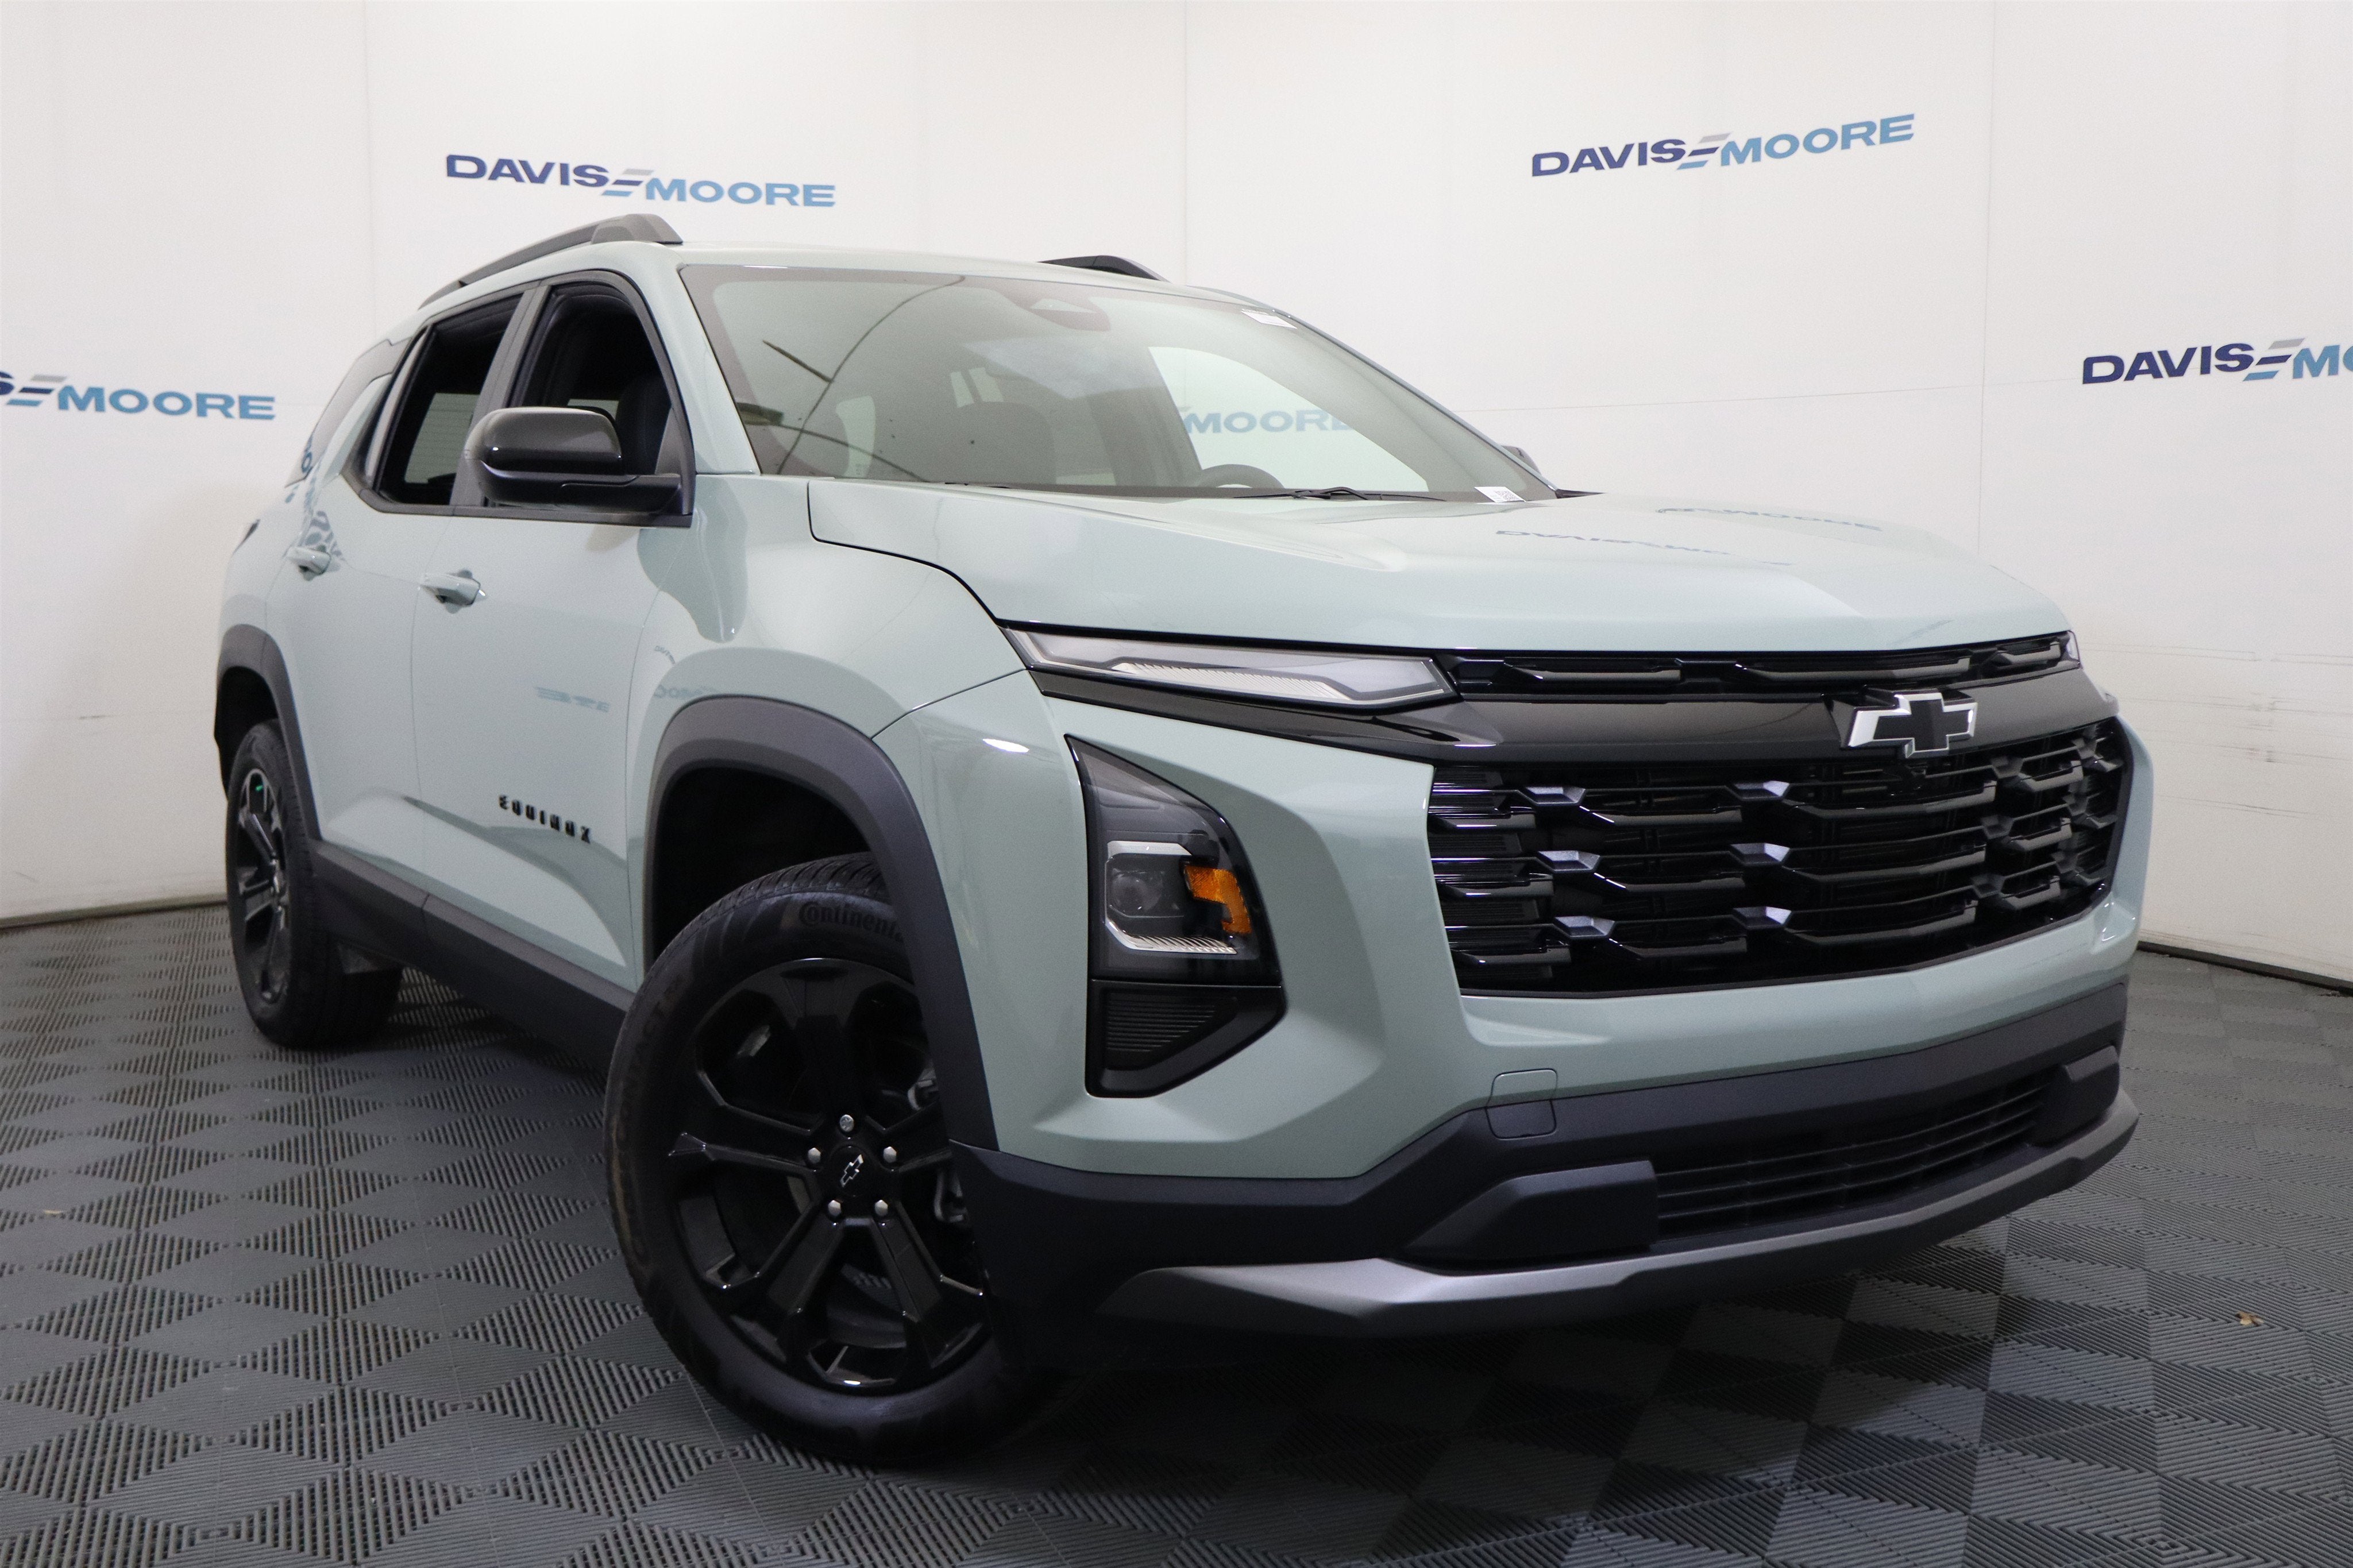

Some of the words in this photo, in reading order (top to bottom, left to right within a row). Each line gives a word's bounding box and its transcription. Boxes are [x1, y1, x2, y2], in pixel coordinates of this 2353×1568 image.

[1532, 139, 1686, 177] DAVIS
[1721, 114, 1914, 167] MOORE
[446, 154, 610, 187] DAVIS
[646, 178, 835, 207] MOORE
[2082, 343, 2254, 384] DAVIS
[57, 384, 275, 420] MOORE
[1184, 409, 1354, 434] MOOR
[499, 795, 591, 843] EQUINOX
